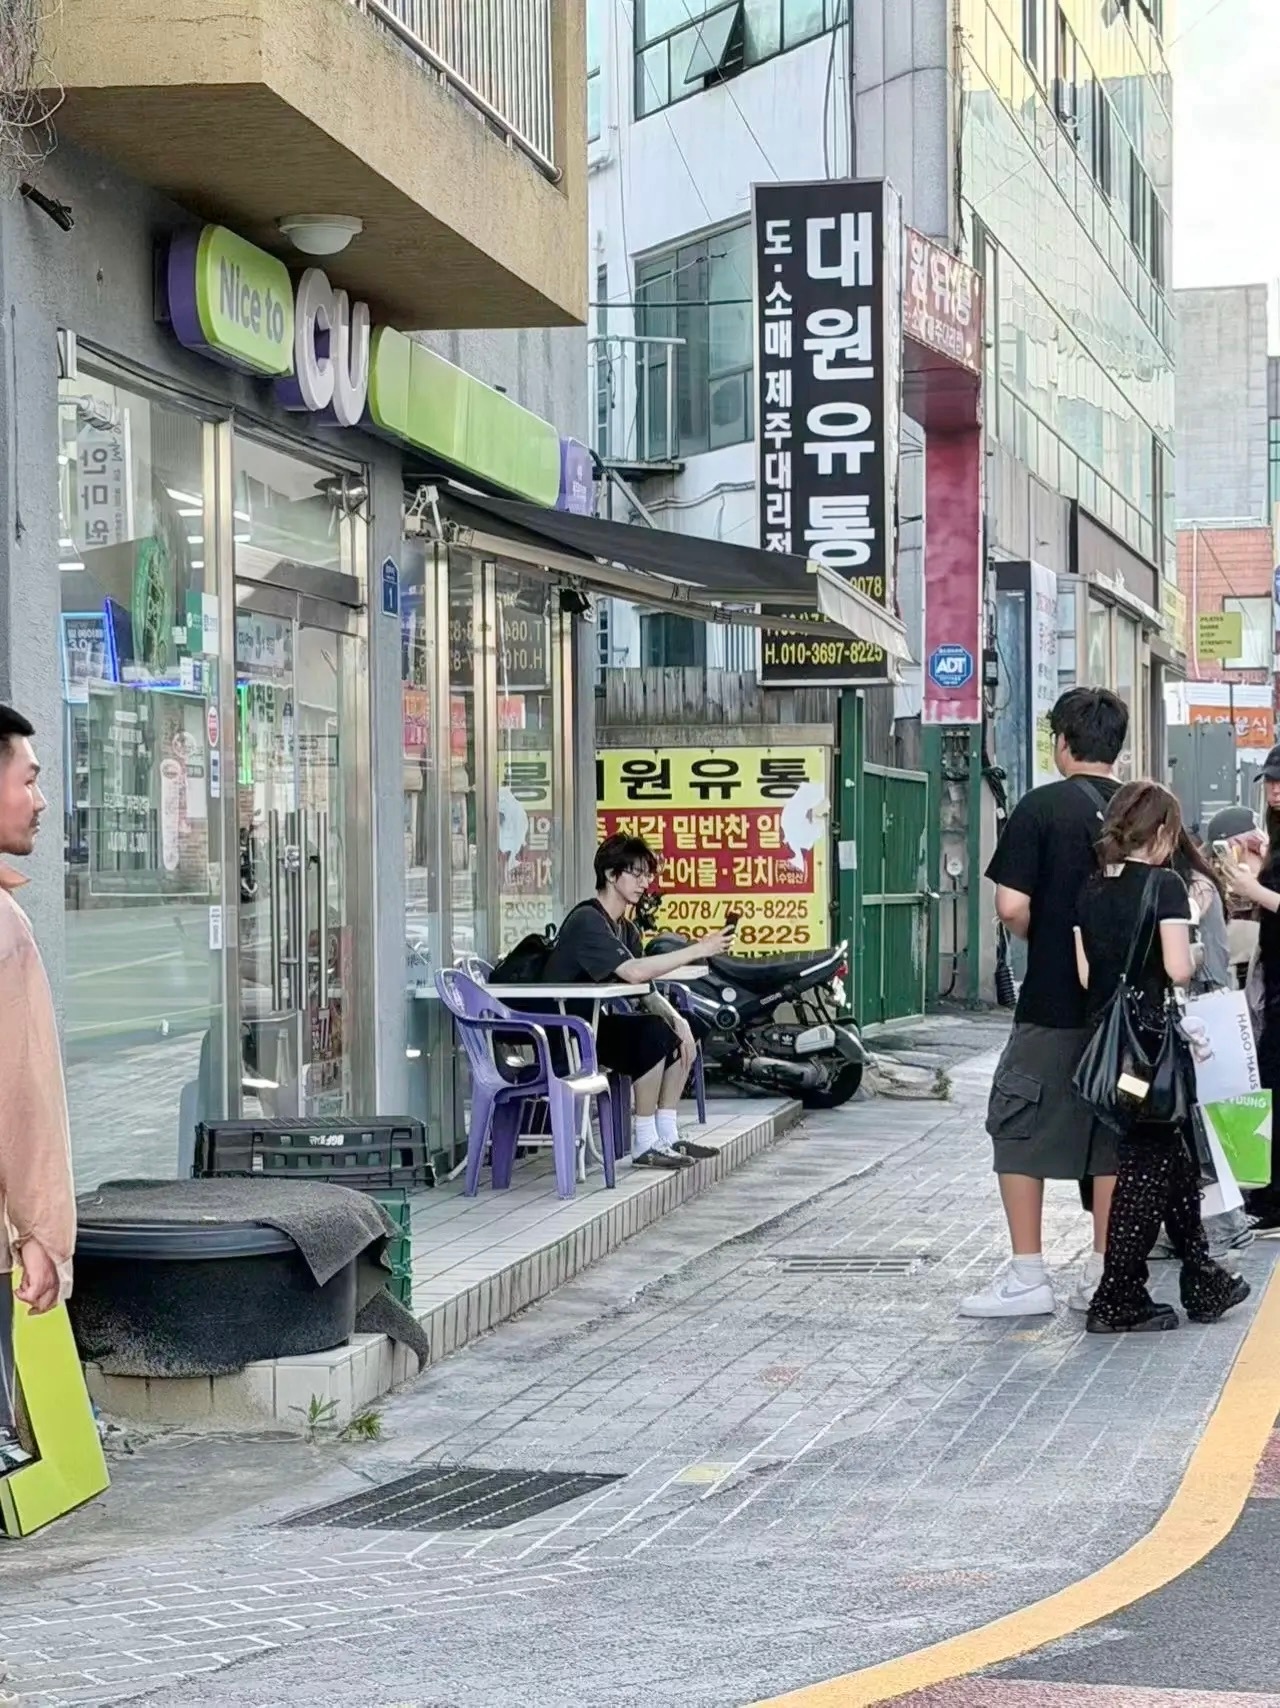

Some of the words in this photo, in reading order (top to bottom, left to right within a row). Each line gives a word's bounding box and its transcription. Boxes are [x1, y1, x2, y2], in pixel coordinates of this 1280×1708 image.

[219, 255, 262, 335] Nice
[264, 287, 285, 344] to
[295, 267, 370, 428] CU
[803, 212, 875, 567] 대원유통
[765, 642, 883, 665] H.010-3697-8225
[935, 657, 966, 674] ADT
[596, 758, 810, 801] 원유통
[673, 814, 750, 849] 밑반찬
